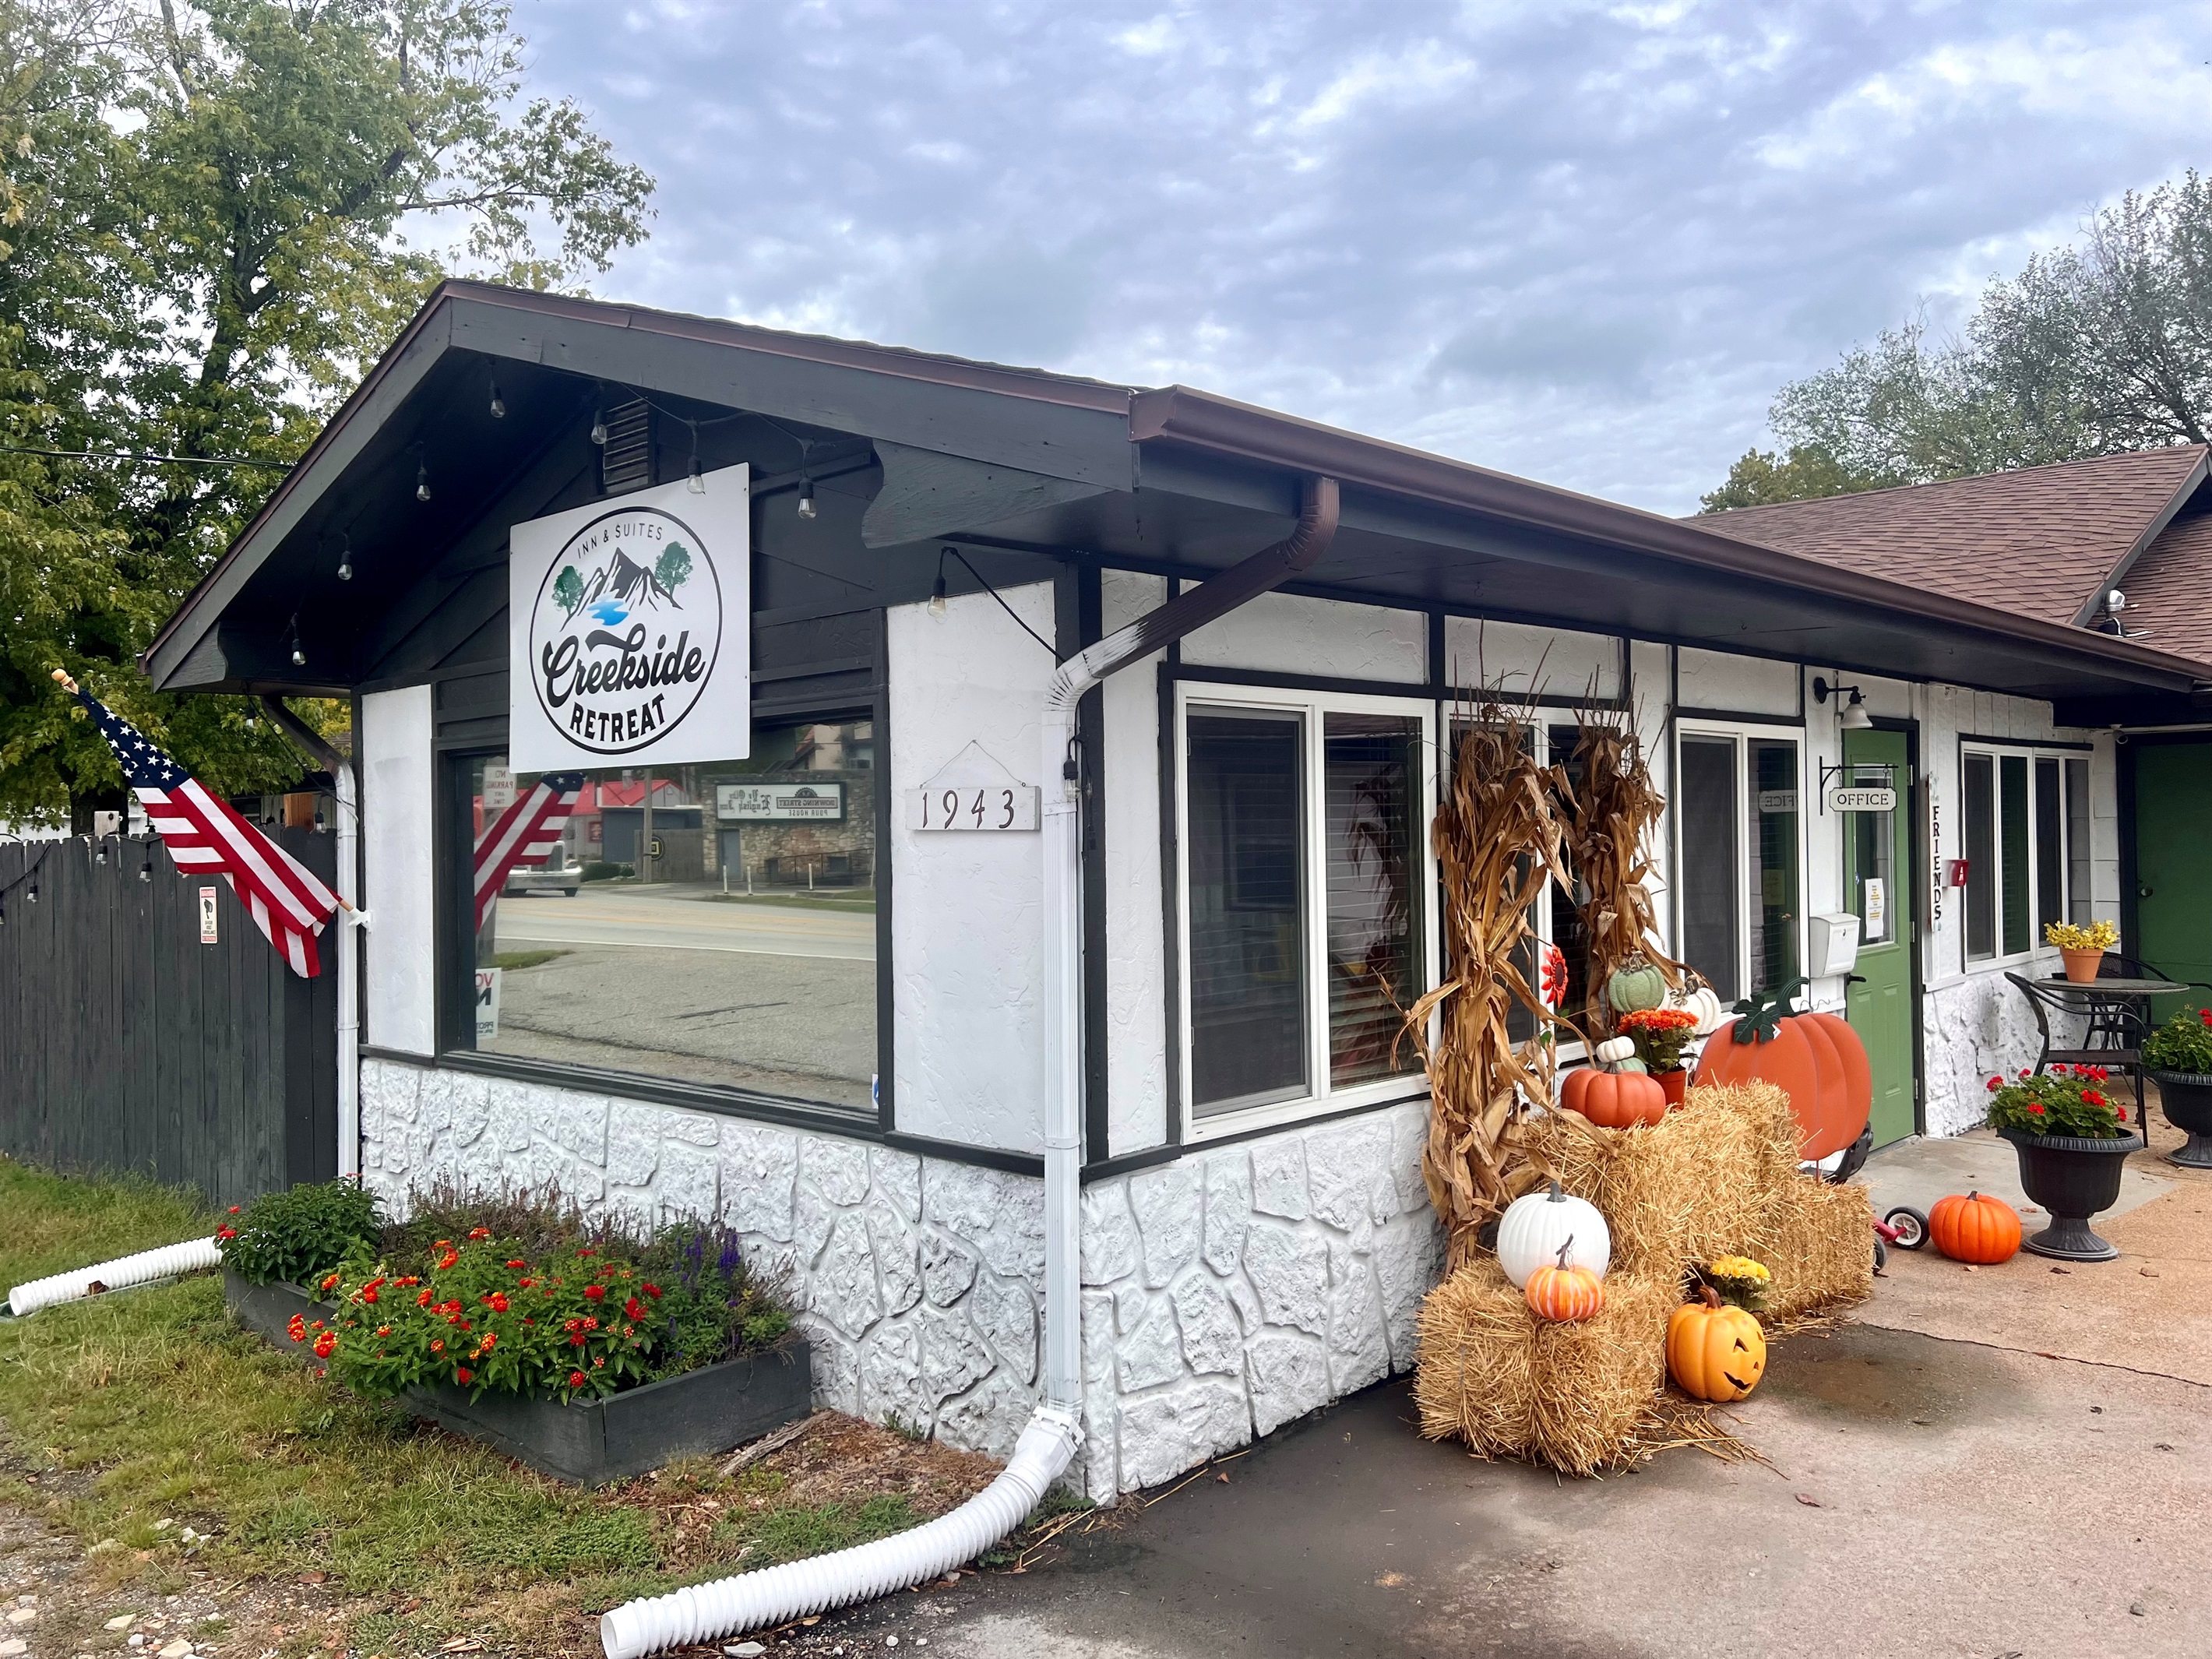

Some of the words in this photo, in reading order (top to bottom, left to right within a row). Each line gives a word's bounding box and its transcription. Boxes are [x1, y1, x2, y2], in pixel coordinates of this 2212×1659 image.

[577, 535, 597, 559] INN
[603, 530, 609, 543] &
[615, 523, 663, 541] SUITES
[541, 623, 706, 708] Creekside
[569, 692, 665, 742] RETREAT
[922, 789, 1014, 829] 1943
[1837, 794, 1889, 805] OFFICE
[1932, 805, 1942, 920] FRIENDS
